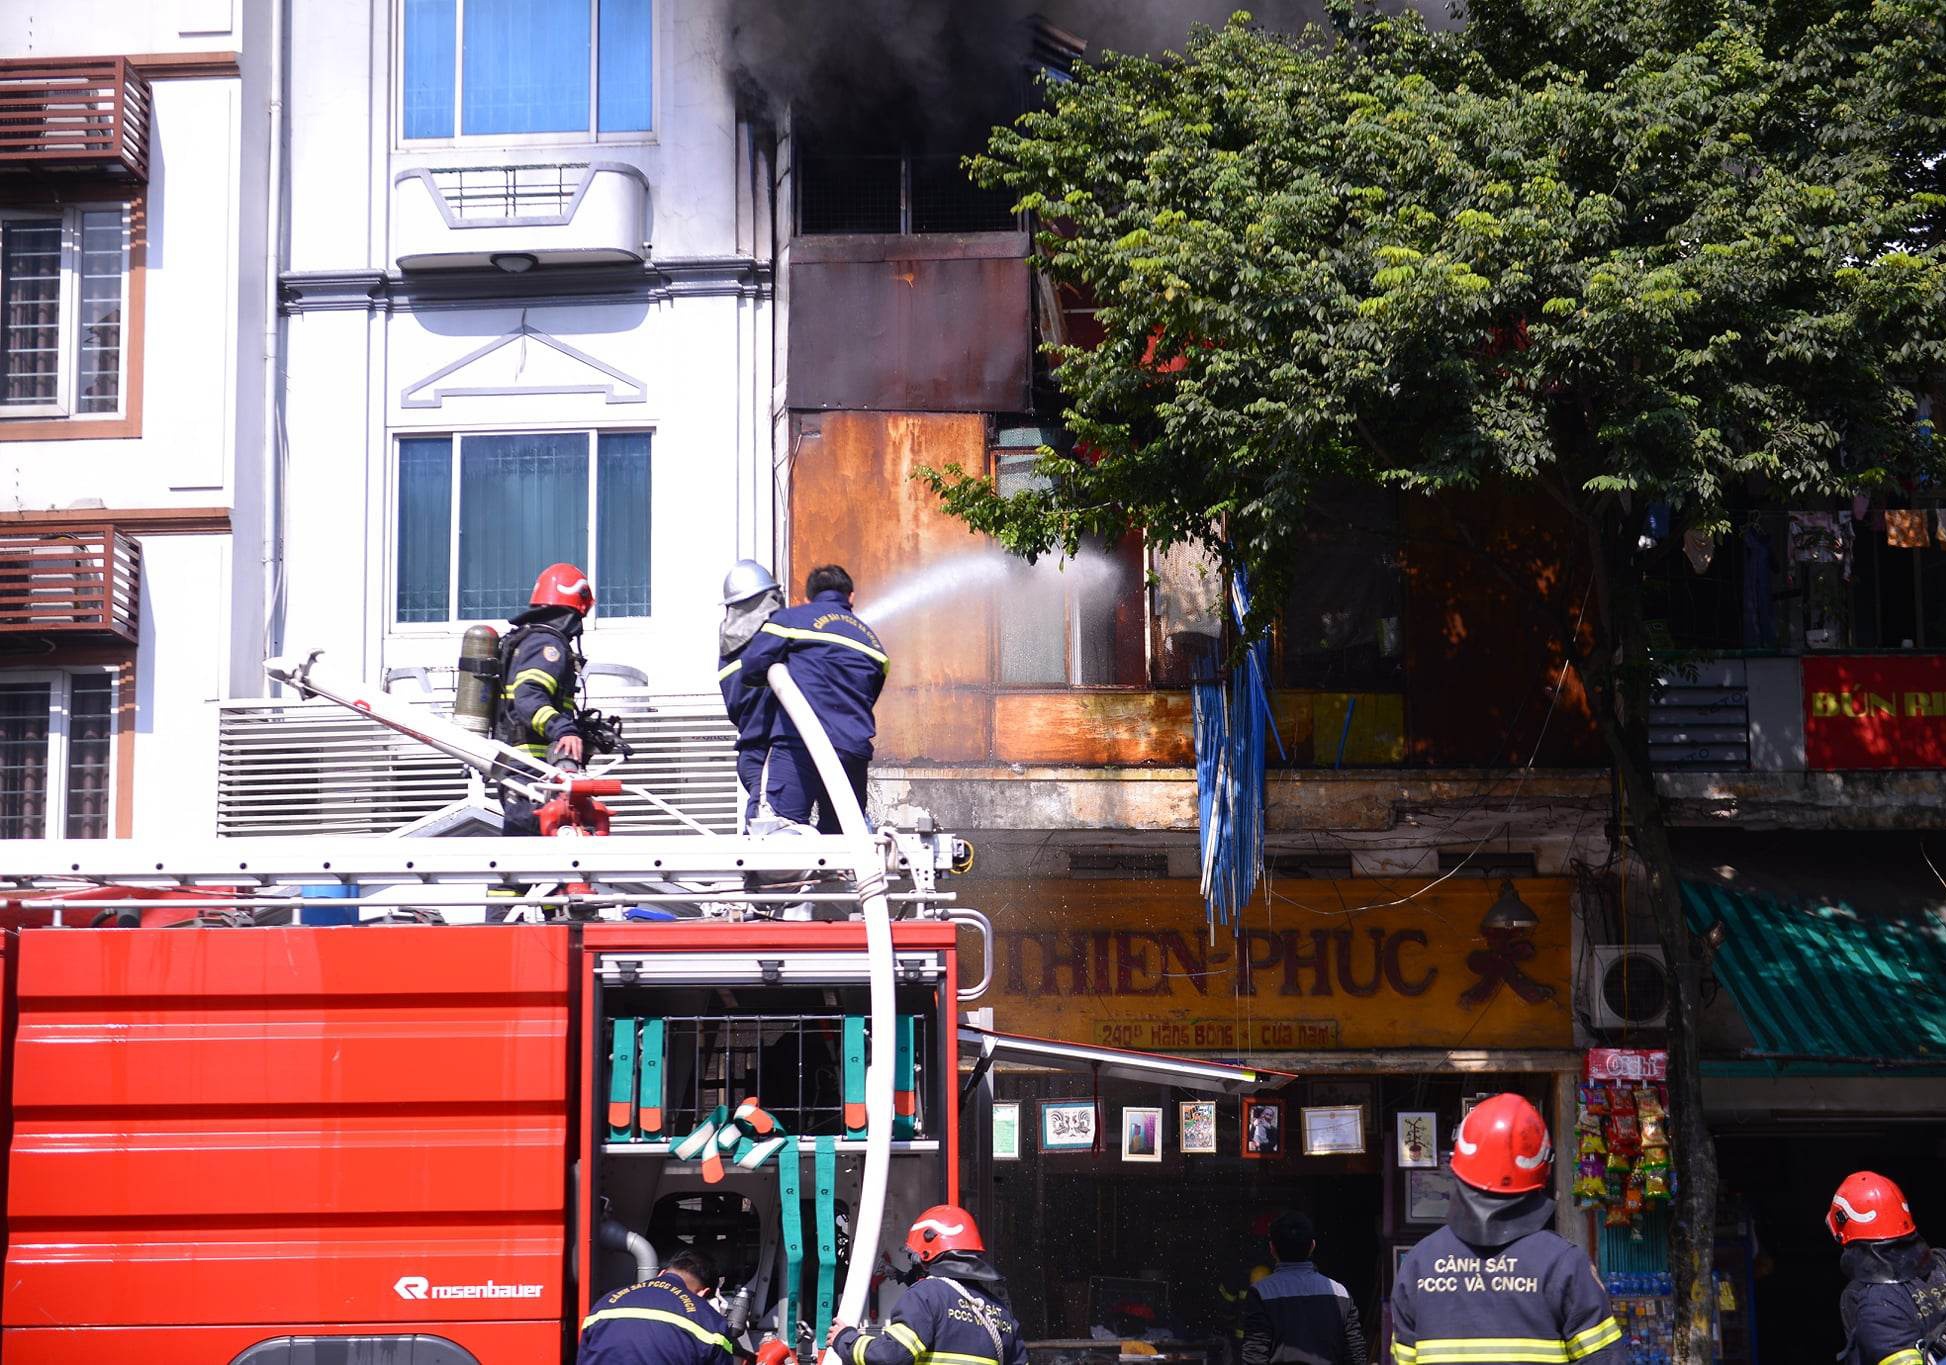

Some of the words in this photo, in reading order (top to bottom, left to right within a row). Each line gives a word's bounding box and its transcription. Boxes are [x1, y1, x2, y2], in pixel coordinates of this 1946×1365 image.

[1812, 684, 1896, 718] BÚN
[1904, 692, 1946, 717] RI
[1434, 1255, 1480, 1272] CẢNH
[1485, 1255, 1518, 1272] SÁT
[432, 1279, 544, 1299] rosenbauer
[1417, 1277, 1457, 1292] PCCC
[1465, 1273, 1486, 1292] VÀ
[1491, 1276, 1538, 1292] CNCH
[947, 1308, 973, 1323] PCCC
